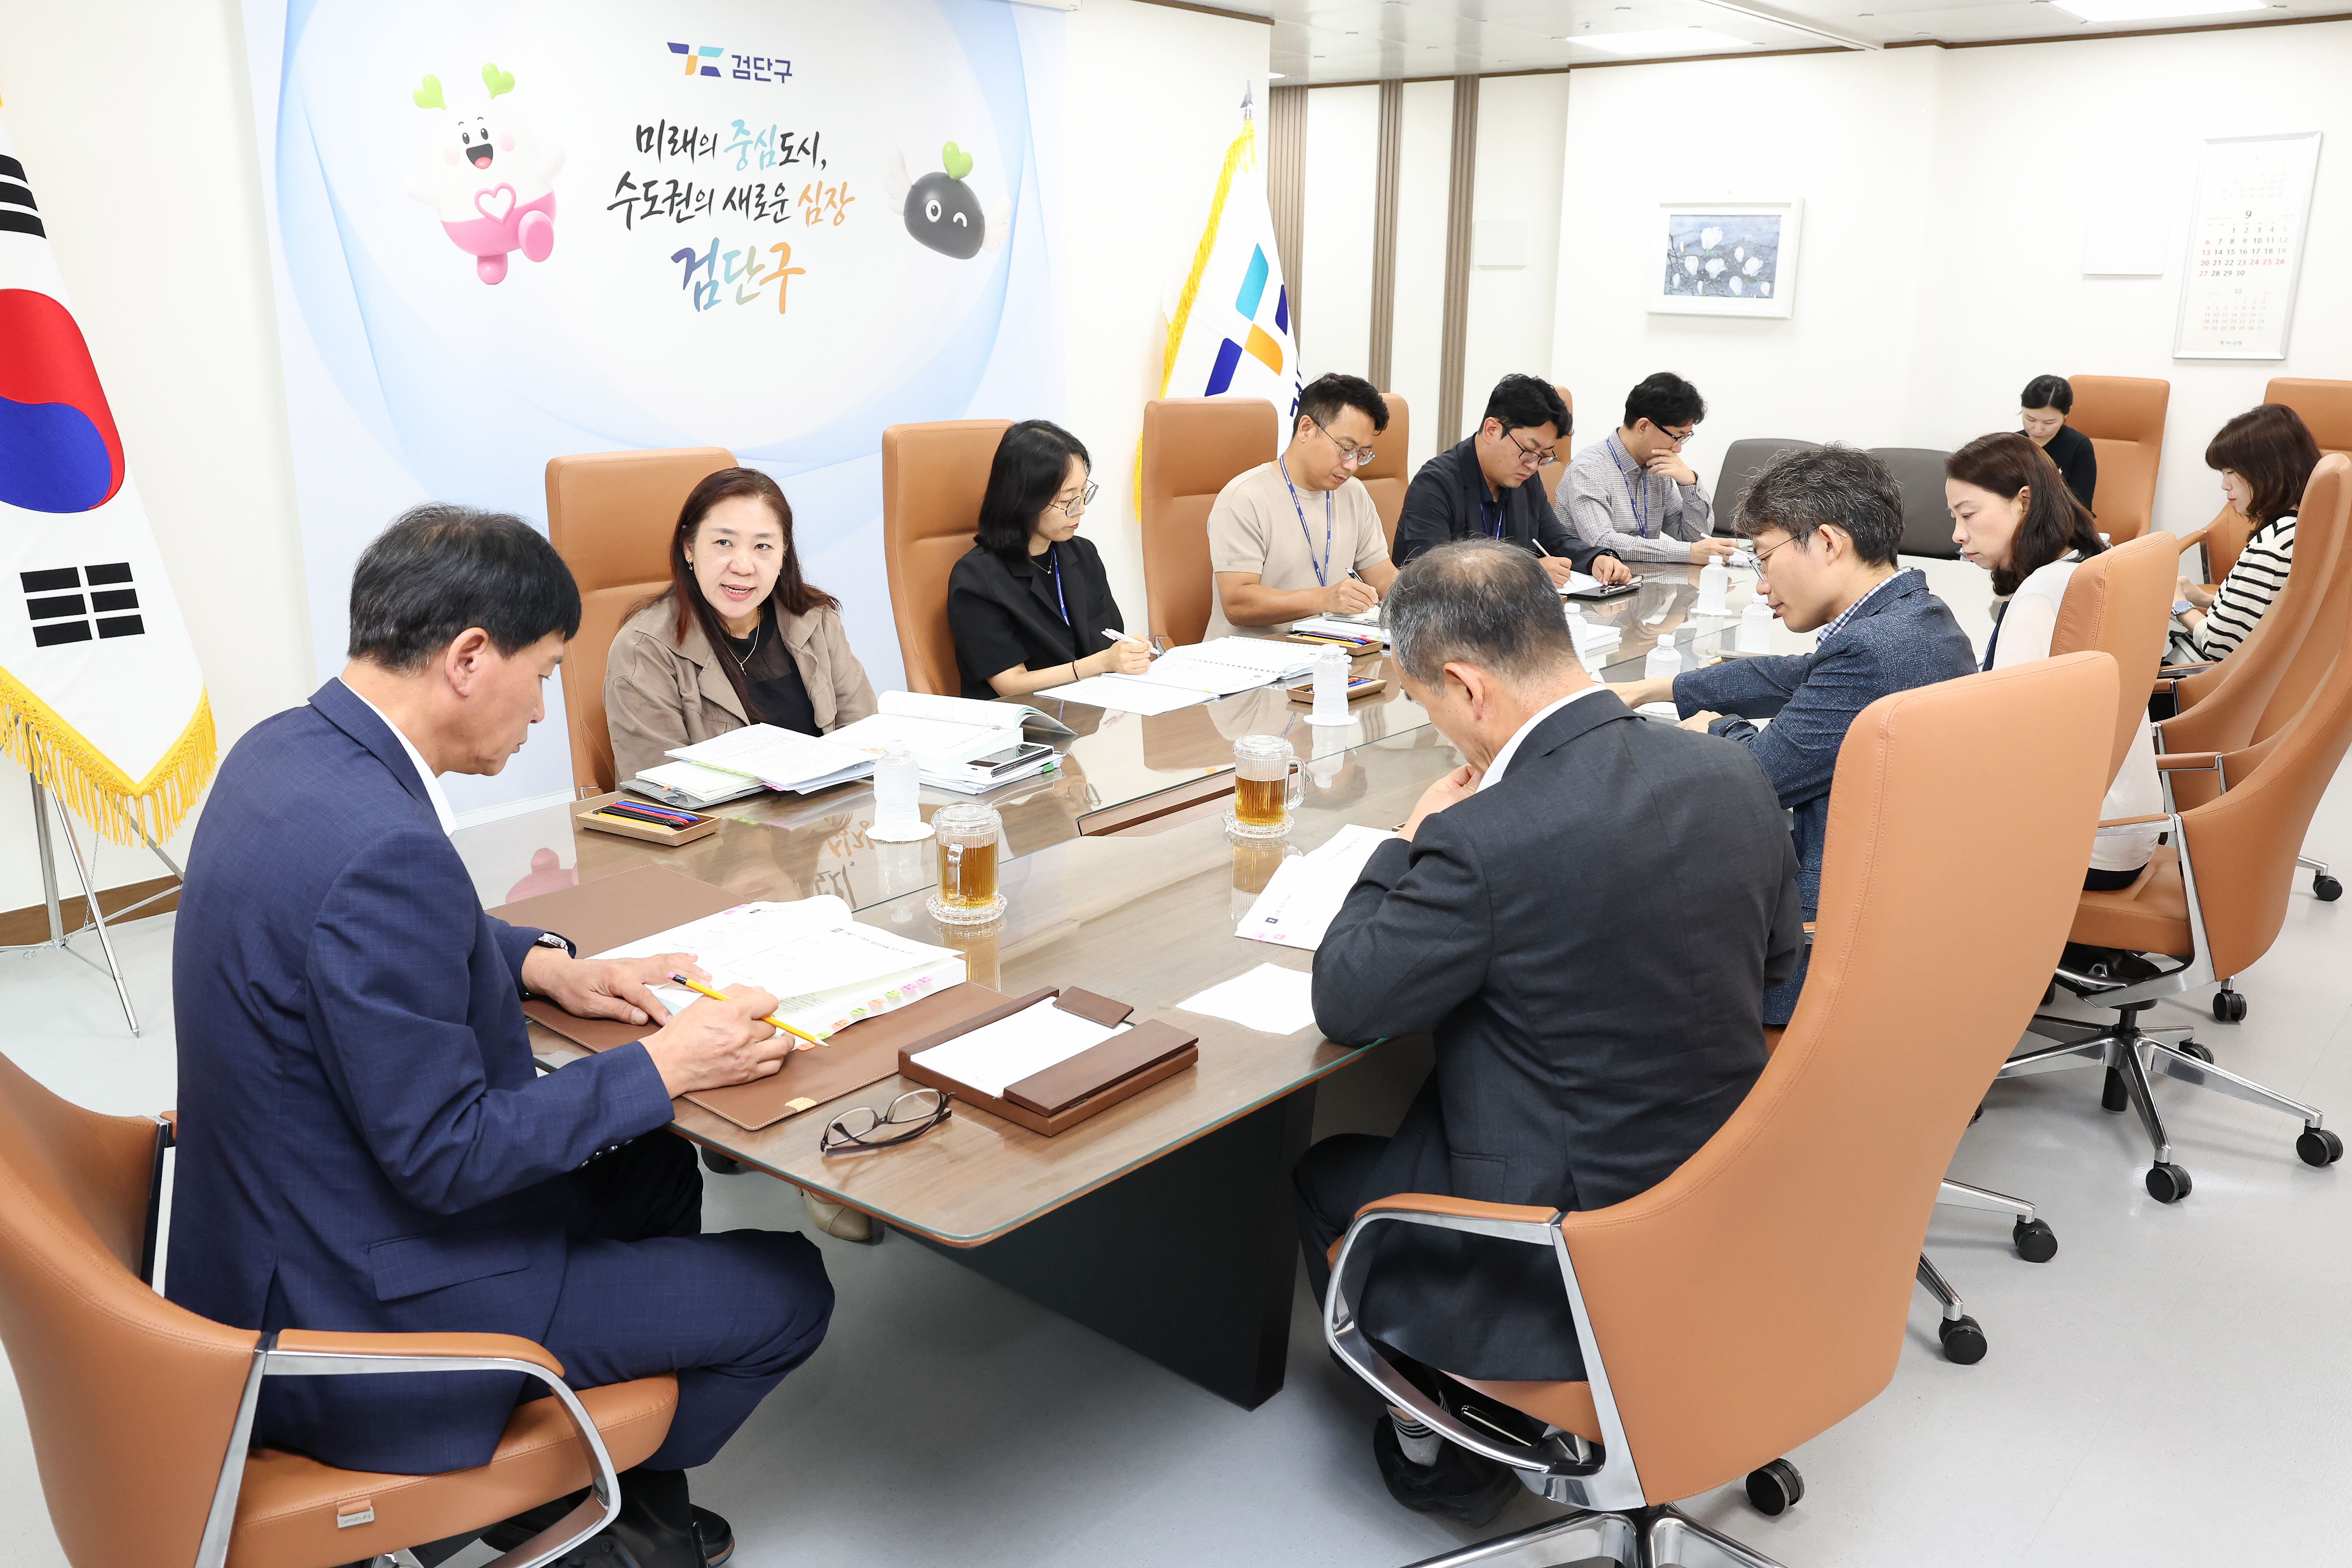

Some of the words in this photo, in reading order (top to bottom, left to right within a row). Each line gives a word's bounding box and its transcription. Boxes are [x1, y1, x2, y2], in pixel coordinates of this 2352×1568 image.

[731, 54, 792, 83] 검단구
[636, 118, 717, 165] 미래의
[606, 171, 715, 231] 수도권의
[722, 182, 792, 223] 새로운
[797, 180, 855, 227] 심장
[2246, 211, 2252, 219] 9
[670, 237, 806, 314] 검단구
